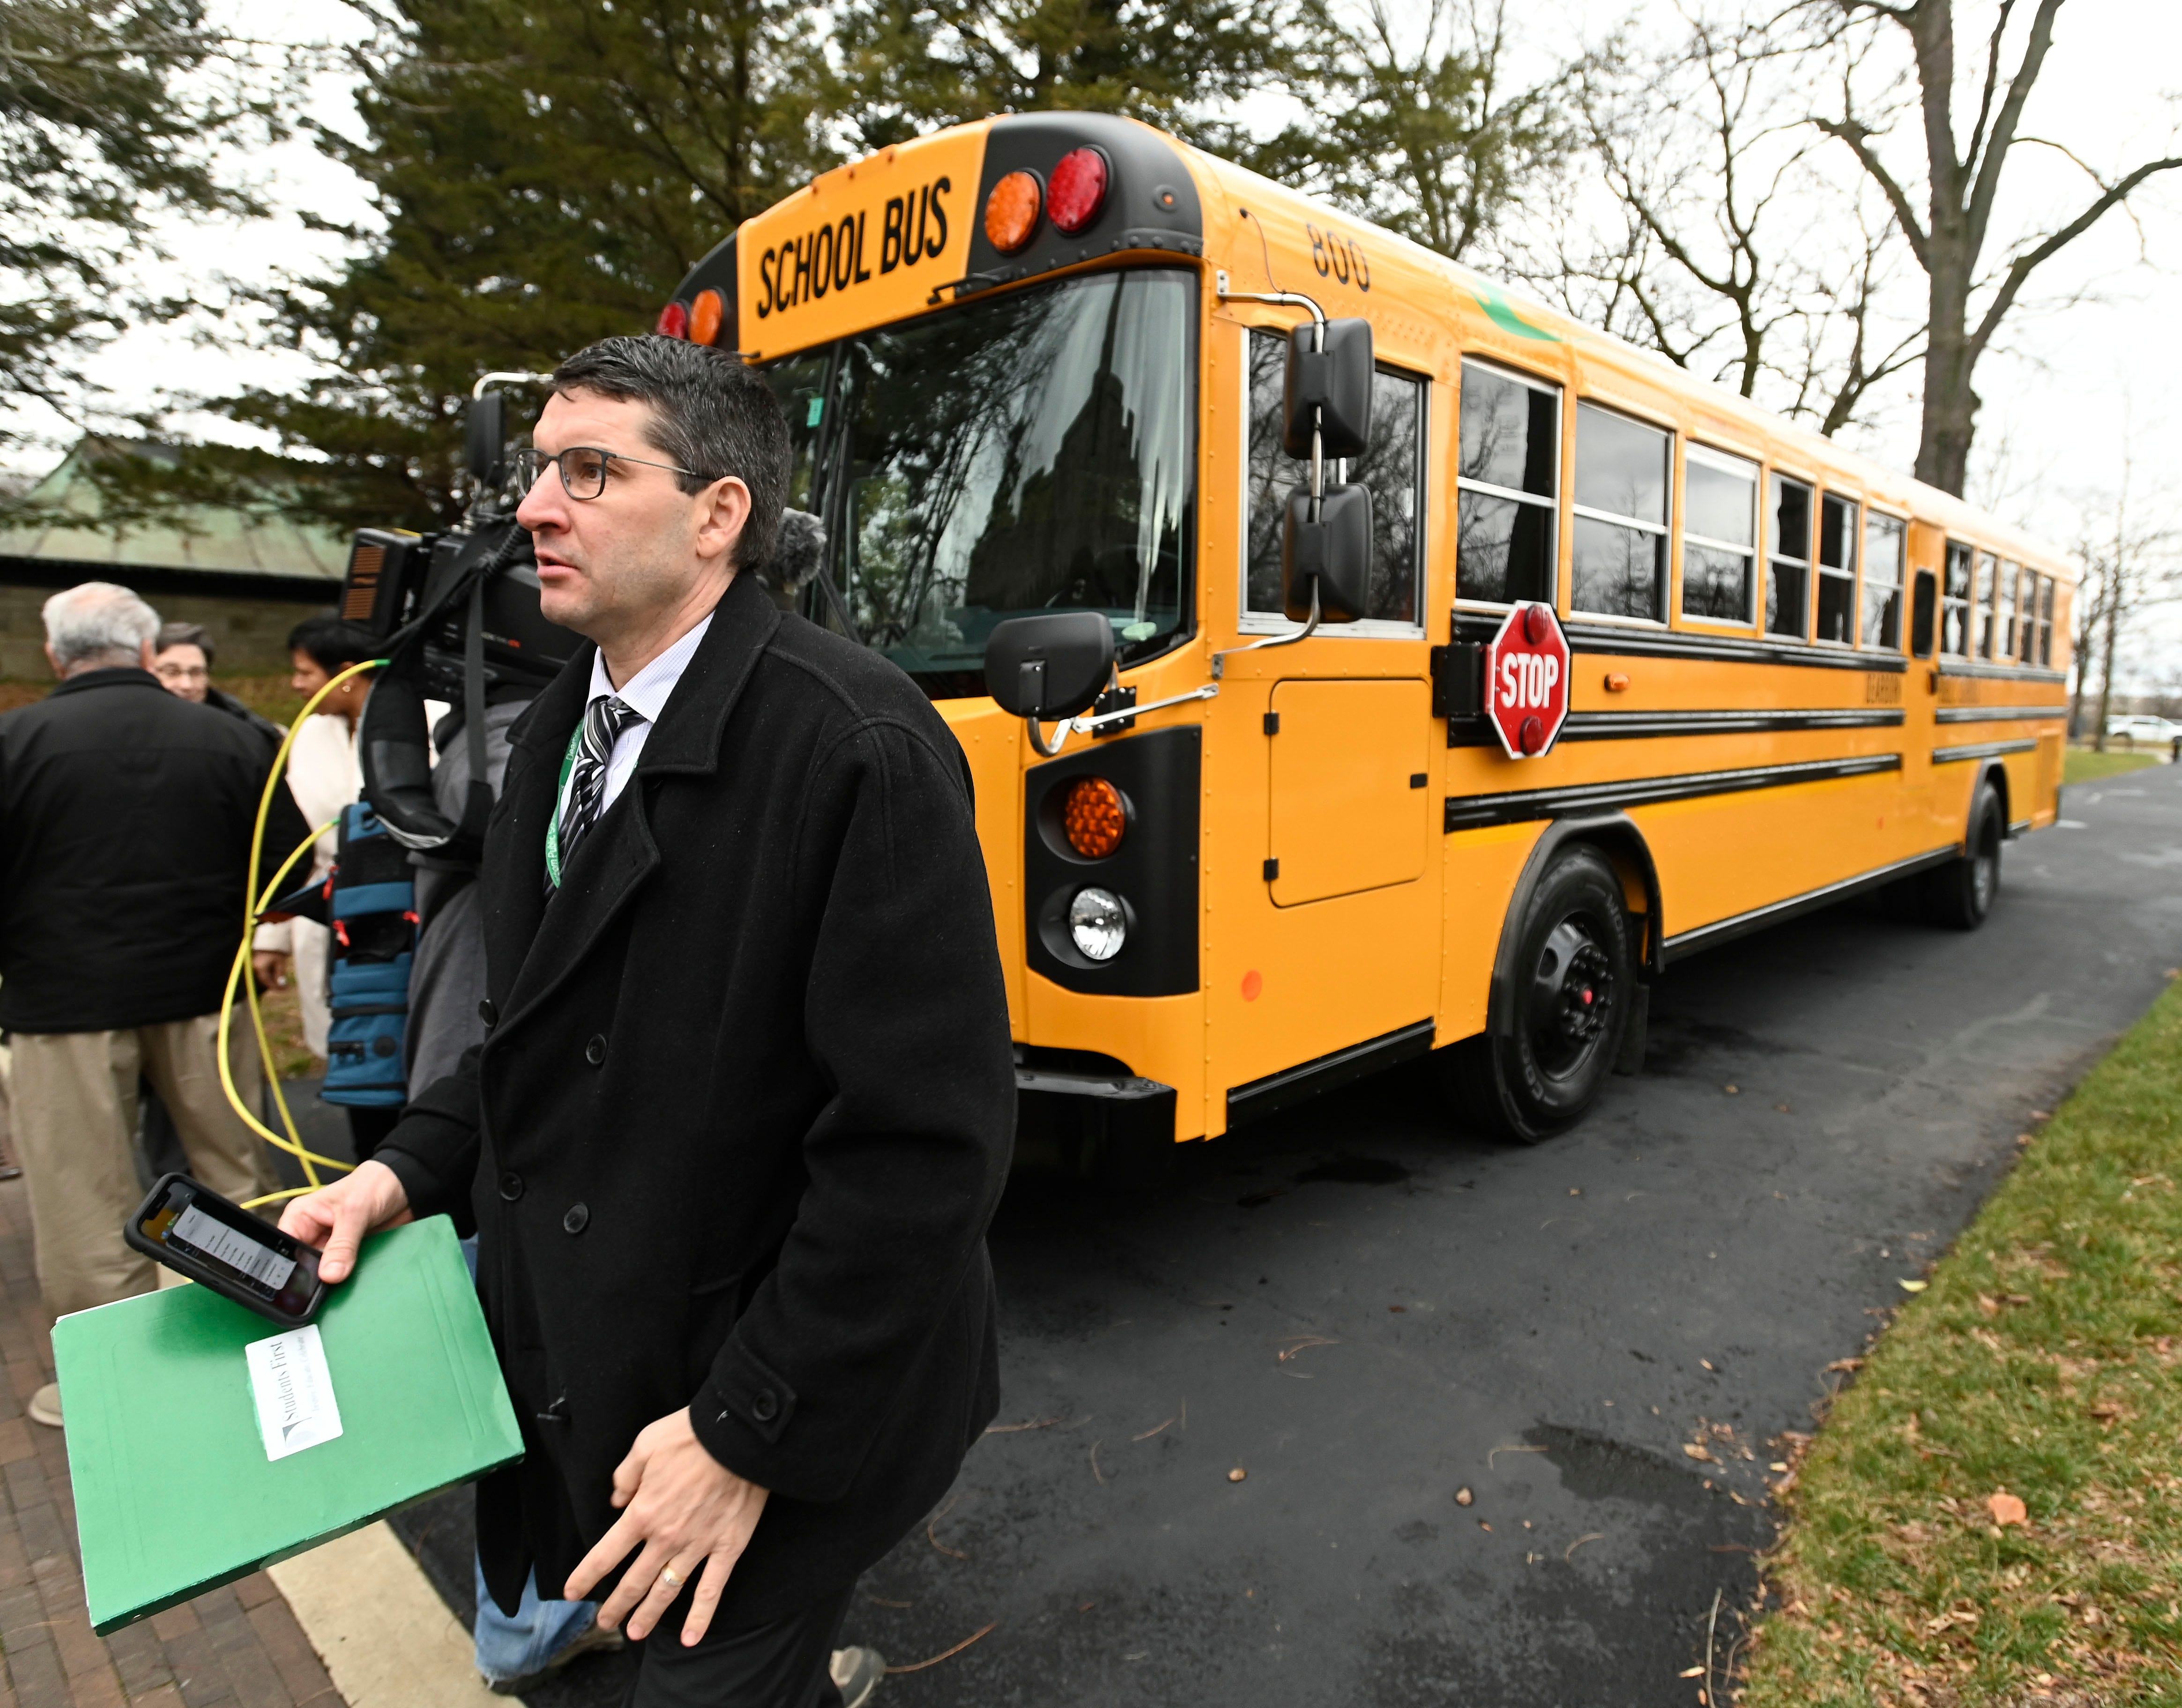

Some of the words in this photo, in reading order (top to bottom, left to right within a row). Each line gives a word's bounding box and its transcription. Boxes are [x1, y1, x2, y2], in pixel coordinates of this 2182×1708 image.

[757, 209, 870, 318] SCHOOL
[880, 176, 951, 275] BUS
[1306, 223, 1370, 292] 800
[1501, 652, 1559, 708] STOP
[269, 1341, 287, 1370] First
[277, 1371, 299, 1422] Students
